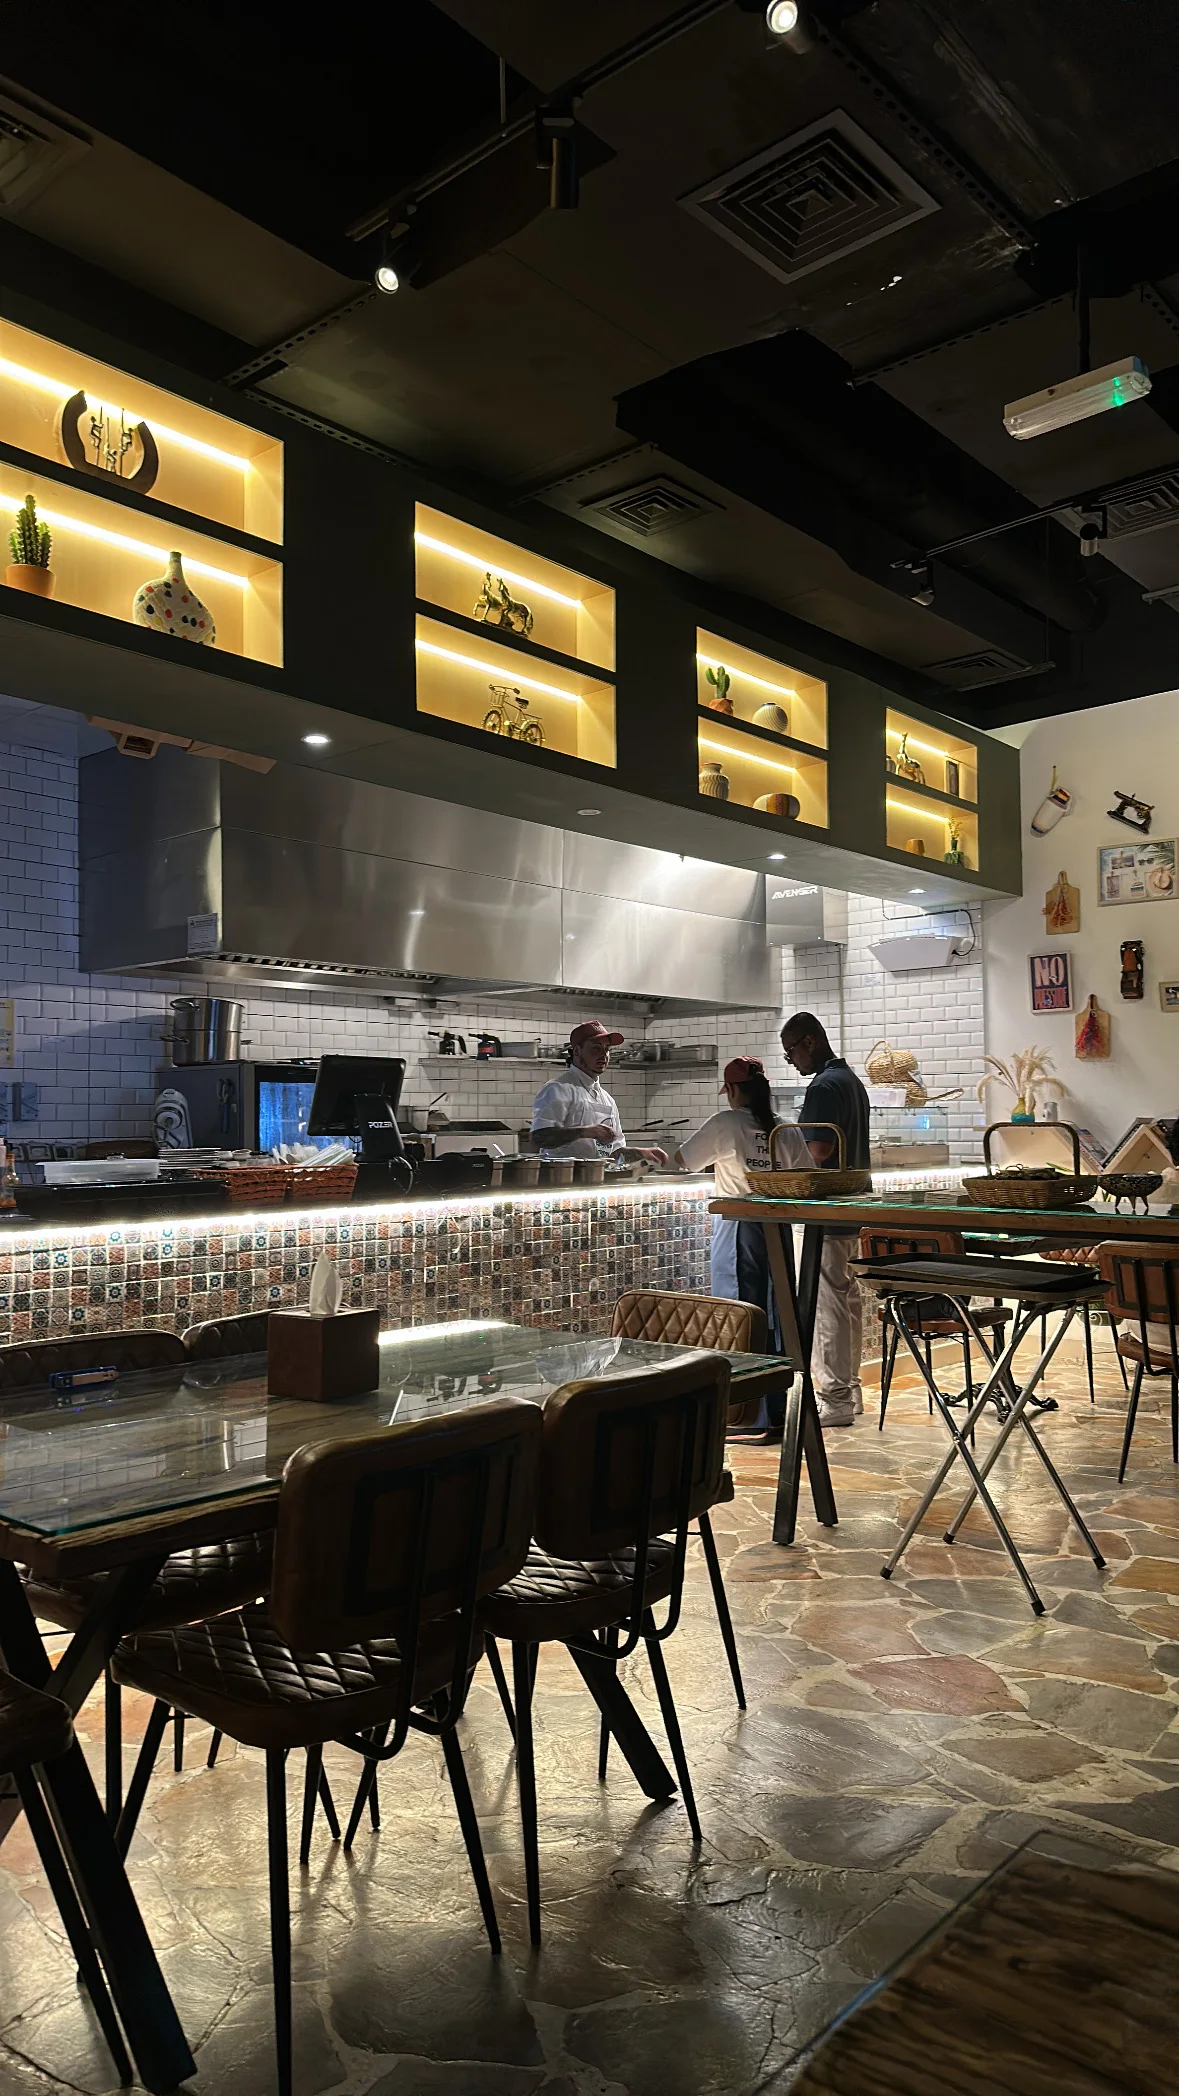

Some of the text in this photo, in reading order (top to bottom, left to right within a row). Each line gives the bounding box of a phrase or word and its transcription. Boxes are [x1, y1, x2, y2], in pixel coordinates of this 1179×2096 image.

[1034, 956, 1064, 987] NO
[755, 1132, 768, 1141] FO
[756, 1145, 770, 1154] TH
[746, 1158, 782, 1169] PEOPE
